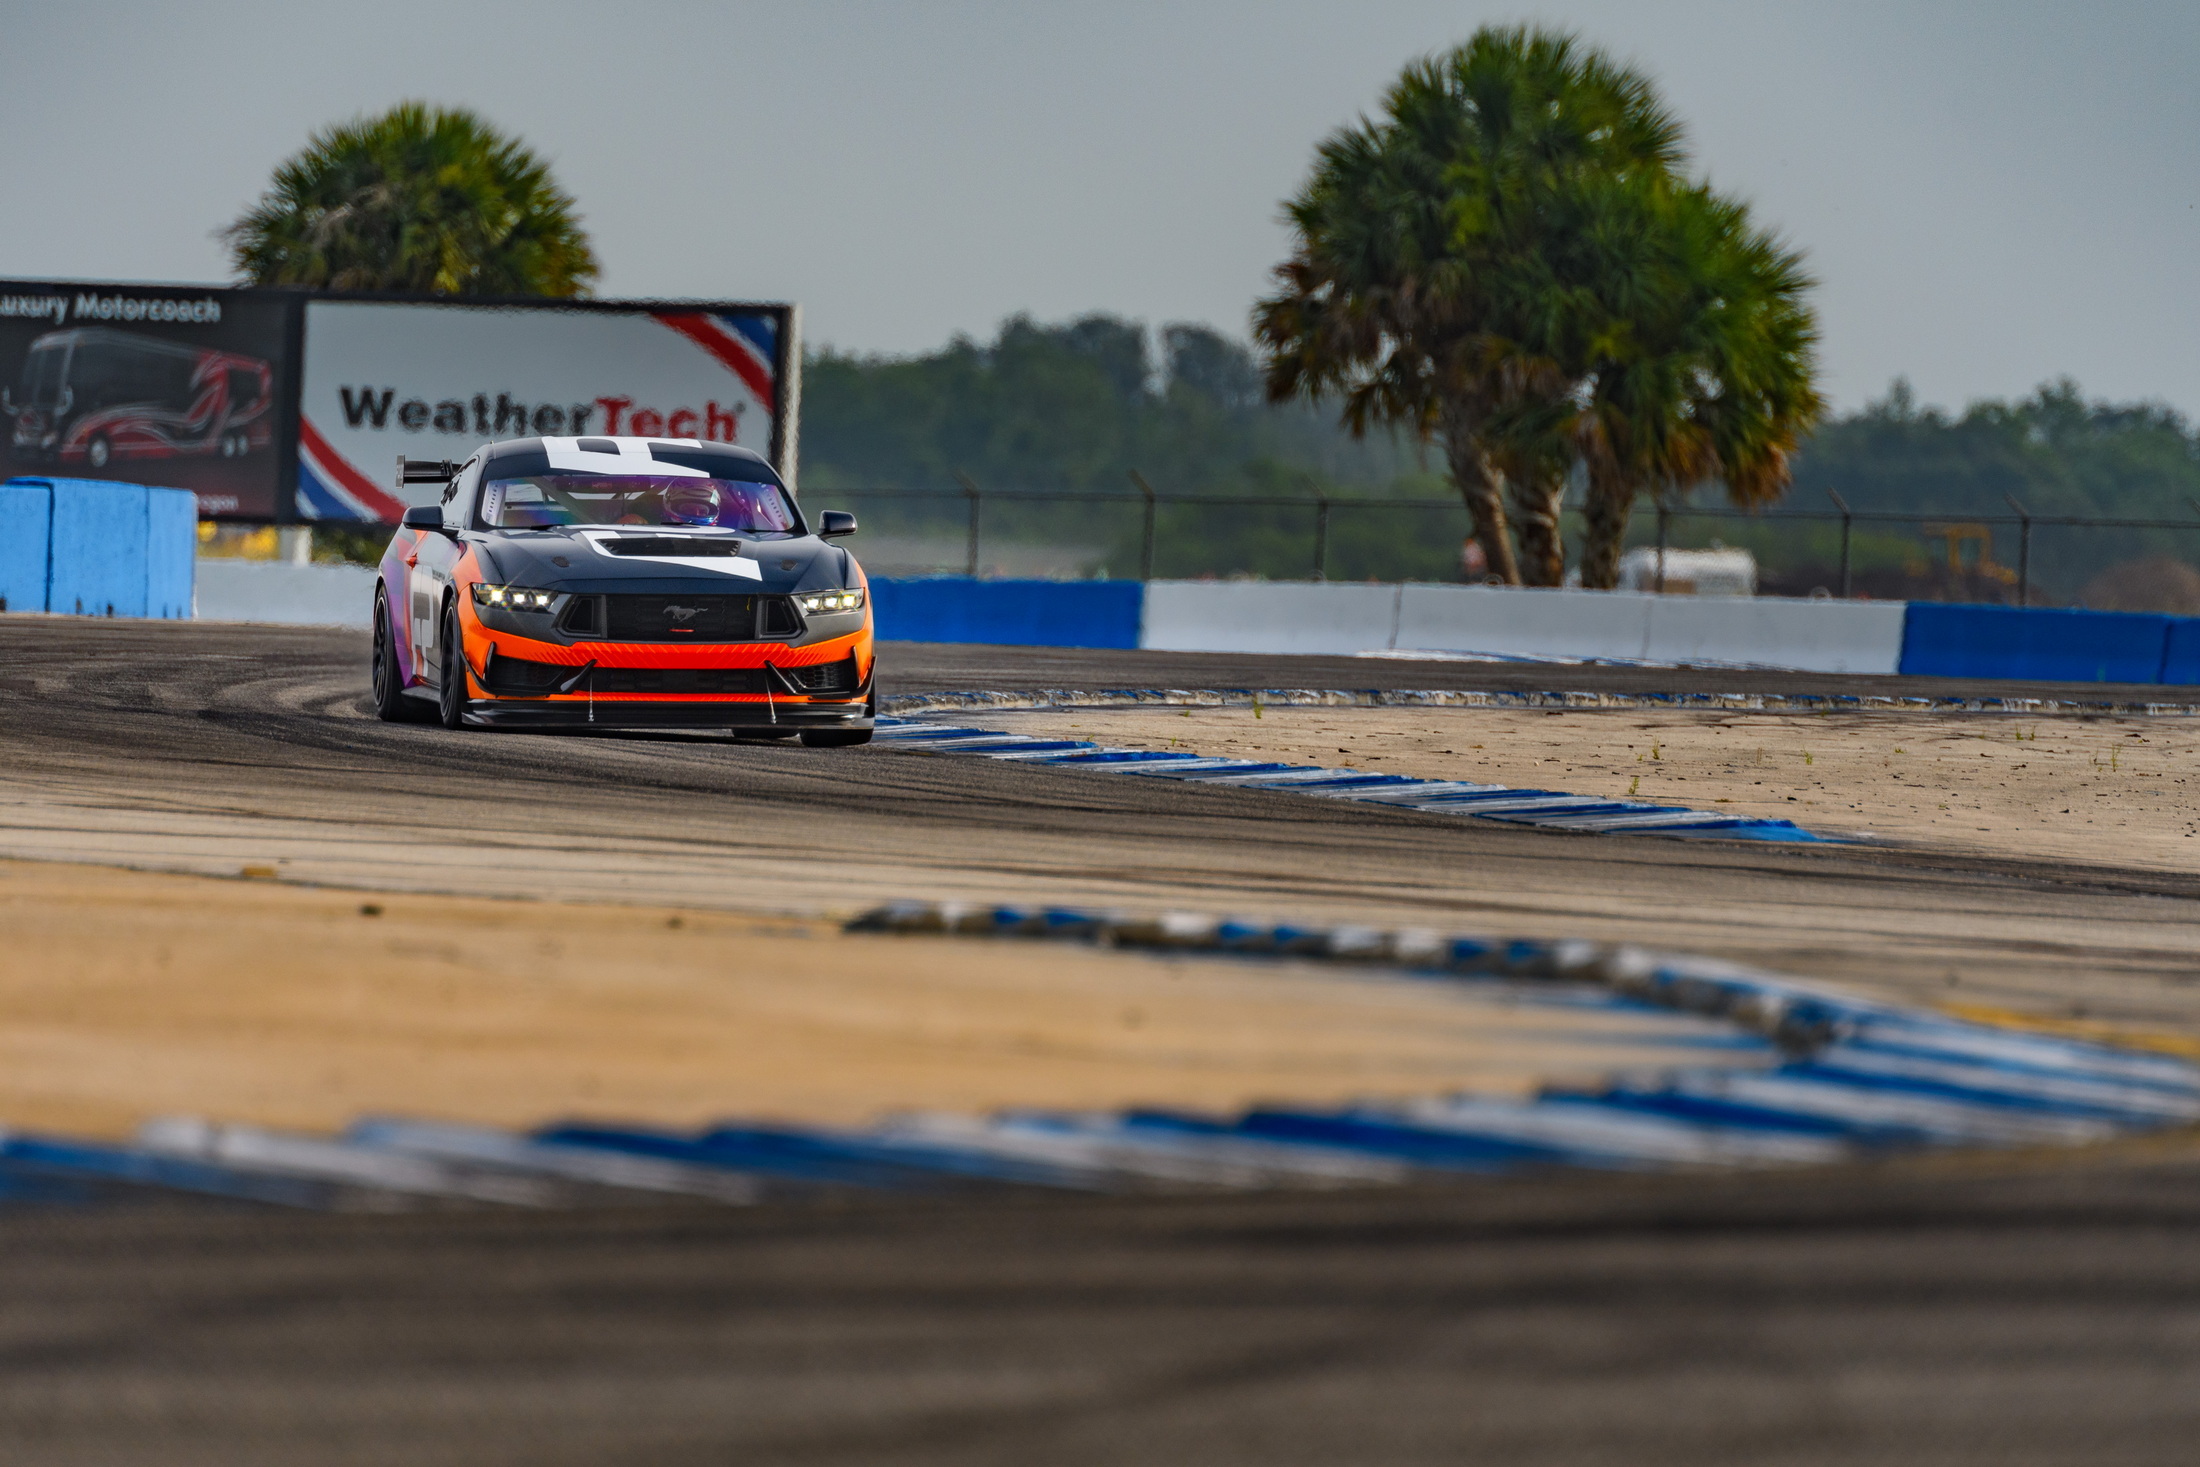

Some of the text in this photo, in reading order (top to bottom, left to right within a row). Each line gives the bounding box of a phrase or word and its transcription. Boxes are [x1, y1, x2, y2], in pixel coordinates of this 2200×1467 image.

[0, 292, 221, 325] uxury Motorcoach
[339, 384, 735, 442] WeatherTech
